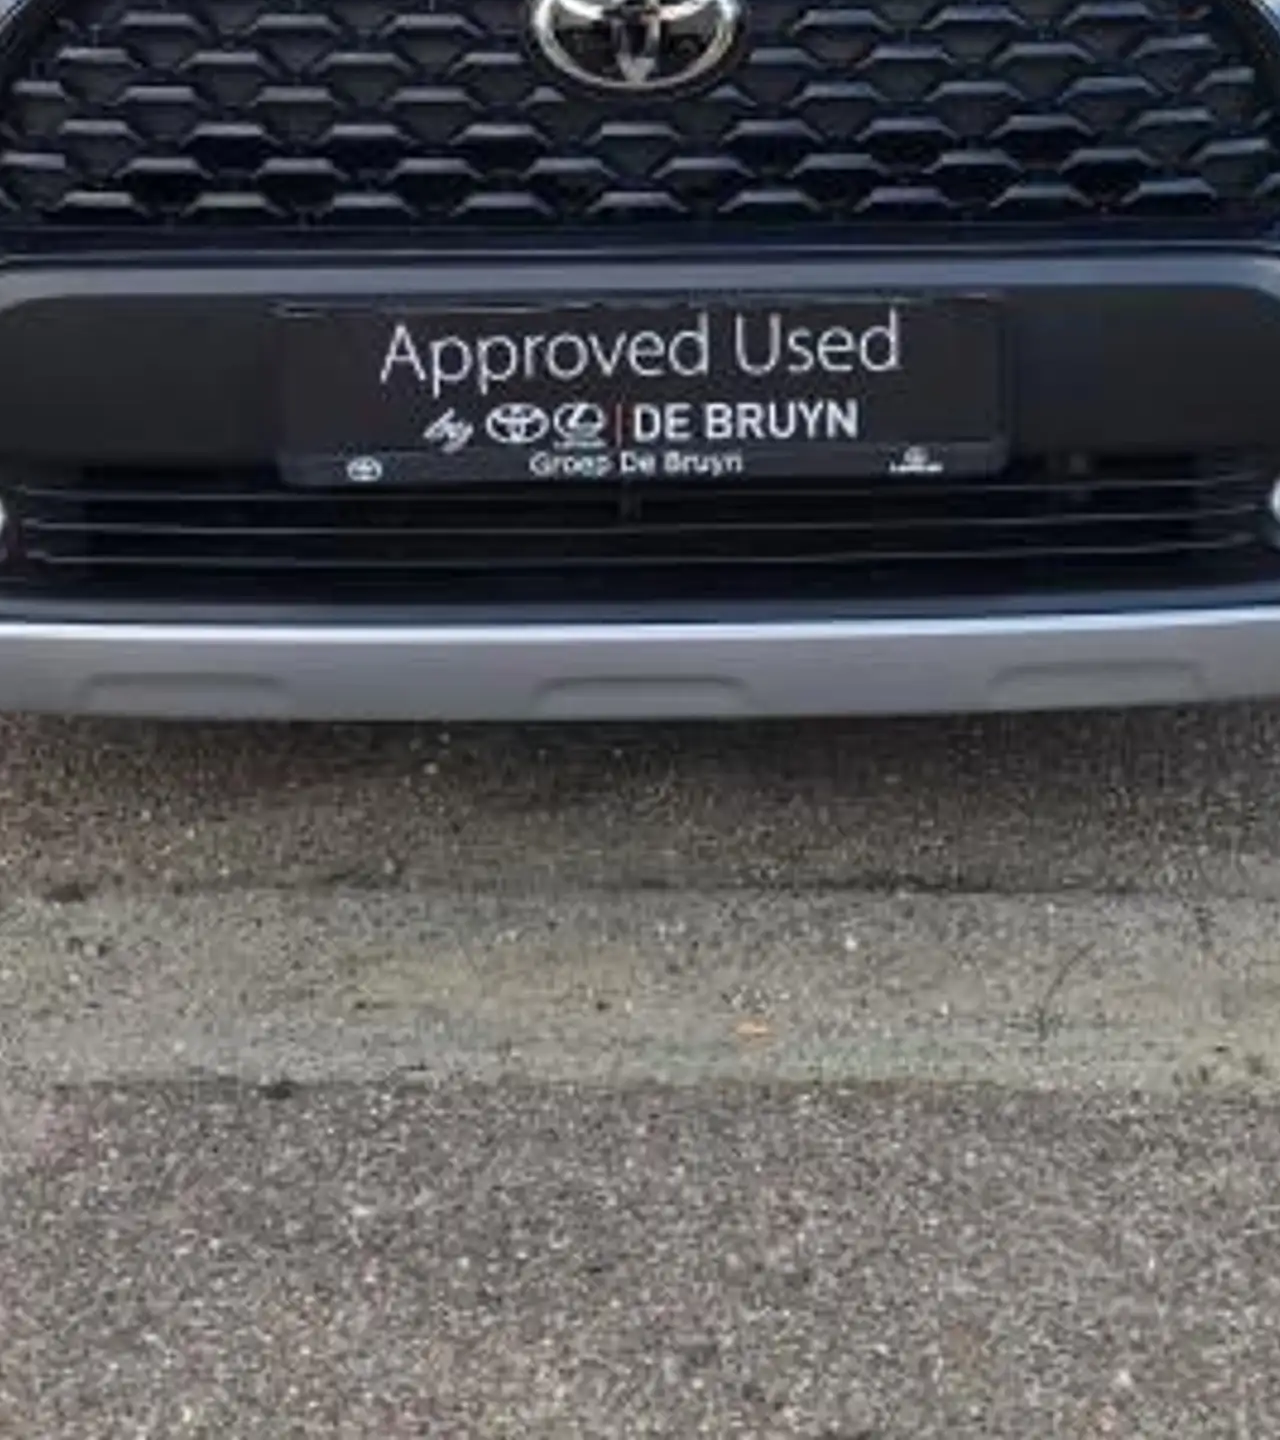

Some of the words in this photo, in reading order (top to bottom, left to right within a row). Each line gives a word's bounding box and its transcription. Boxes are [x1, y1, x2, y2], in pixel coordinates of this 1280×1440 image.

[378, 312, 710, 399] Approved
[735, 307, 902, 374] Used
[633, 402, 691, 442] DE
[704, 397, 859, 440] BRUYN
[620, 449, 656, 474] De
[663, 448, 745, 479] Bruyn
